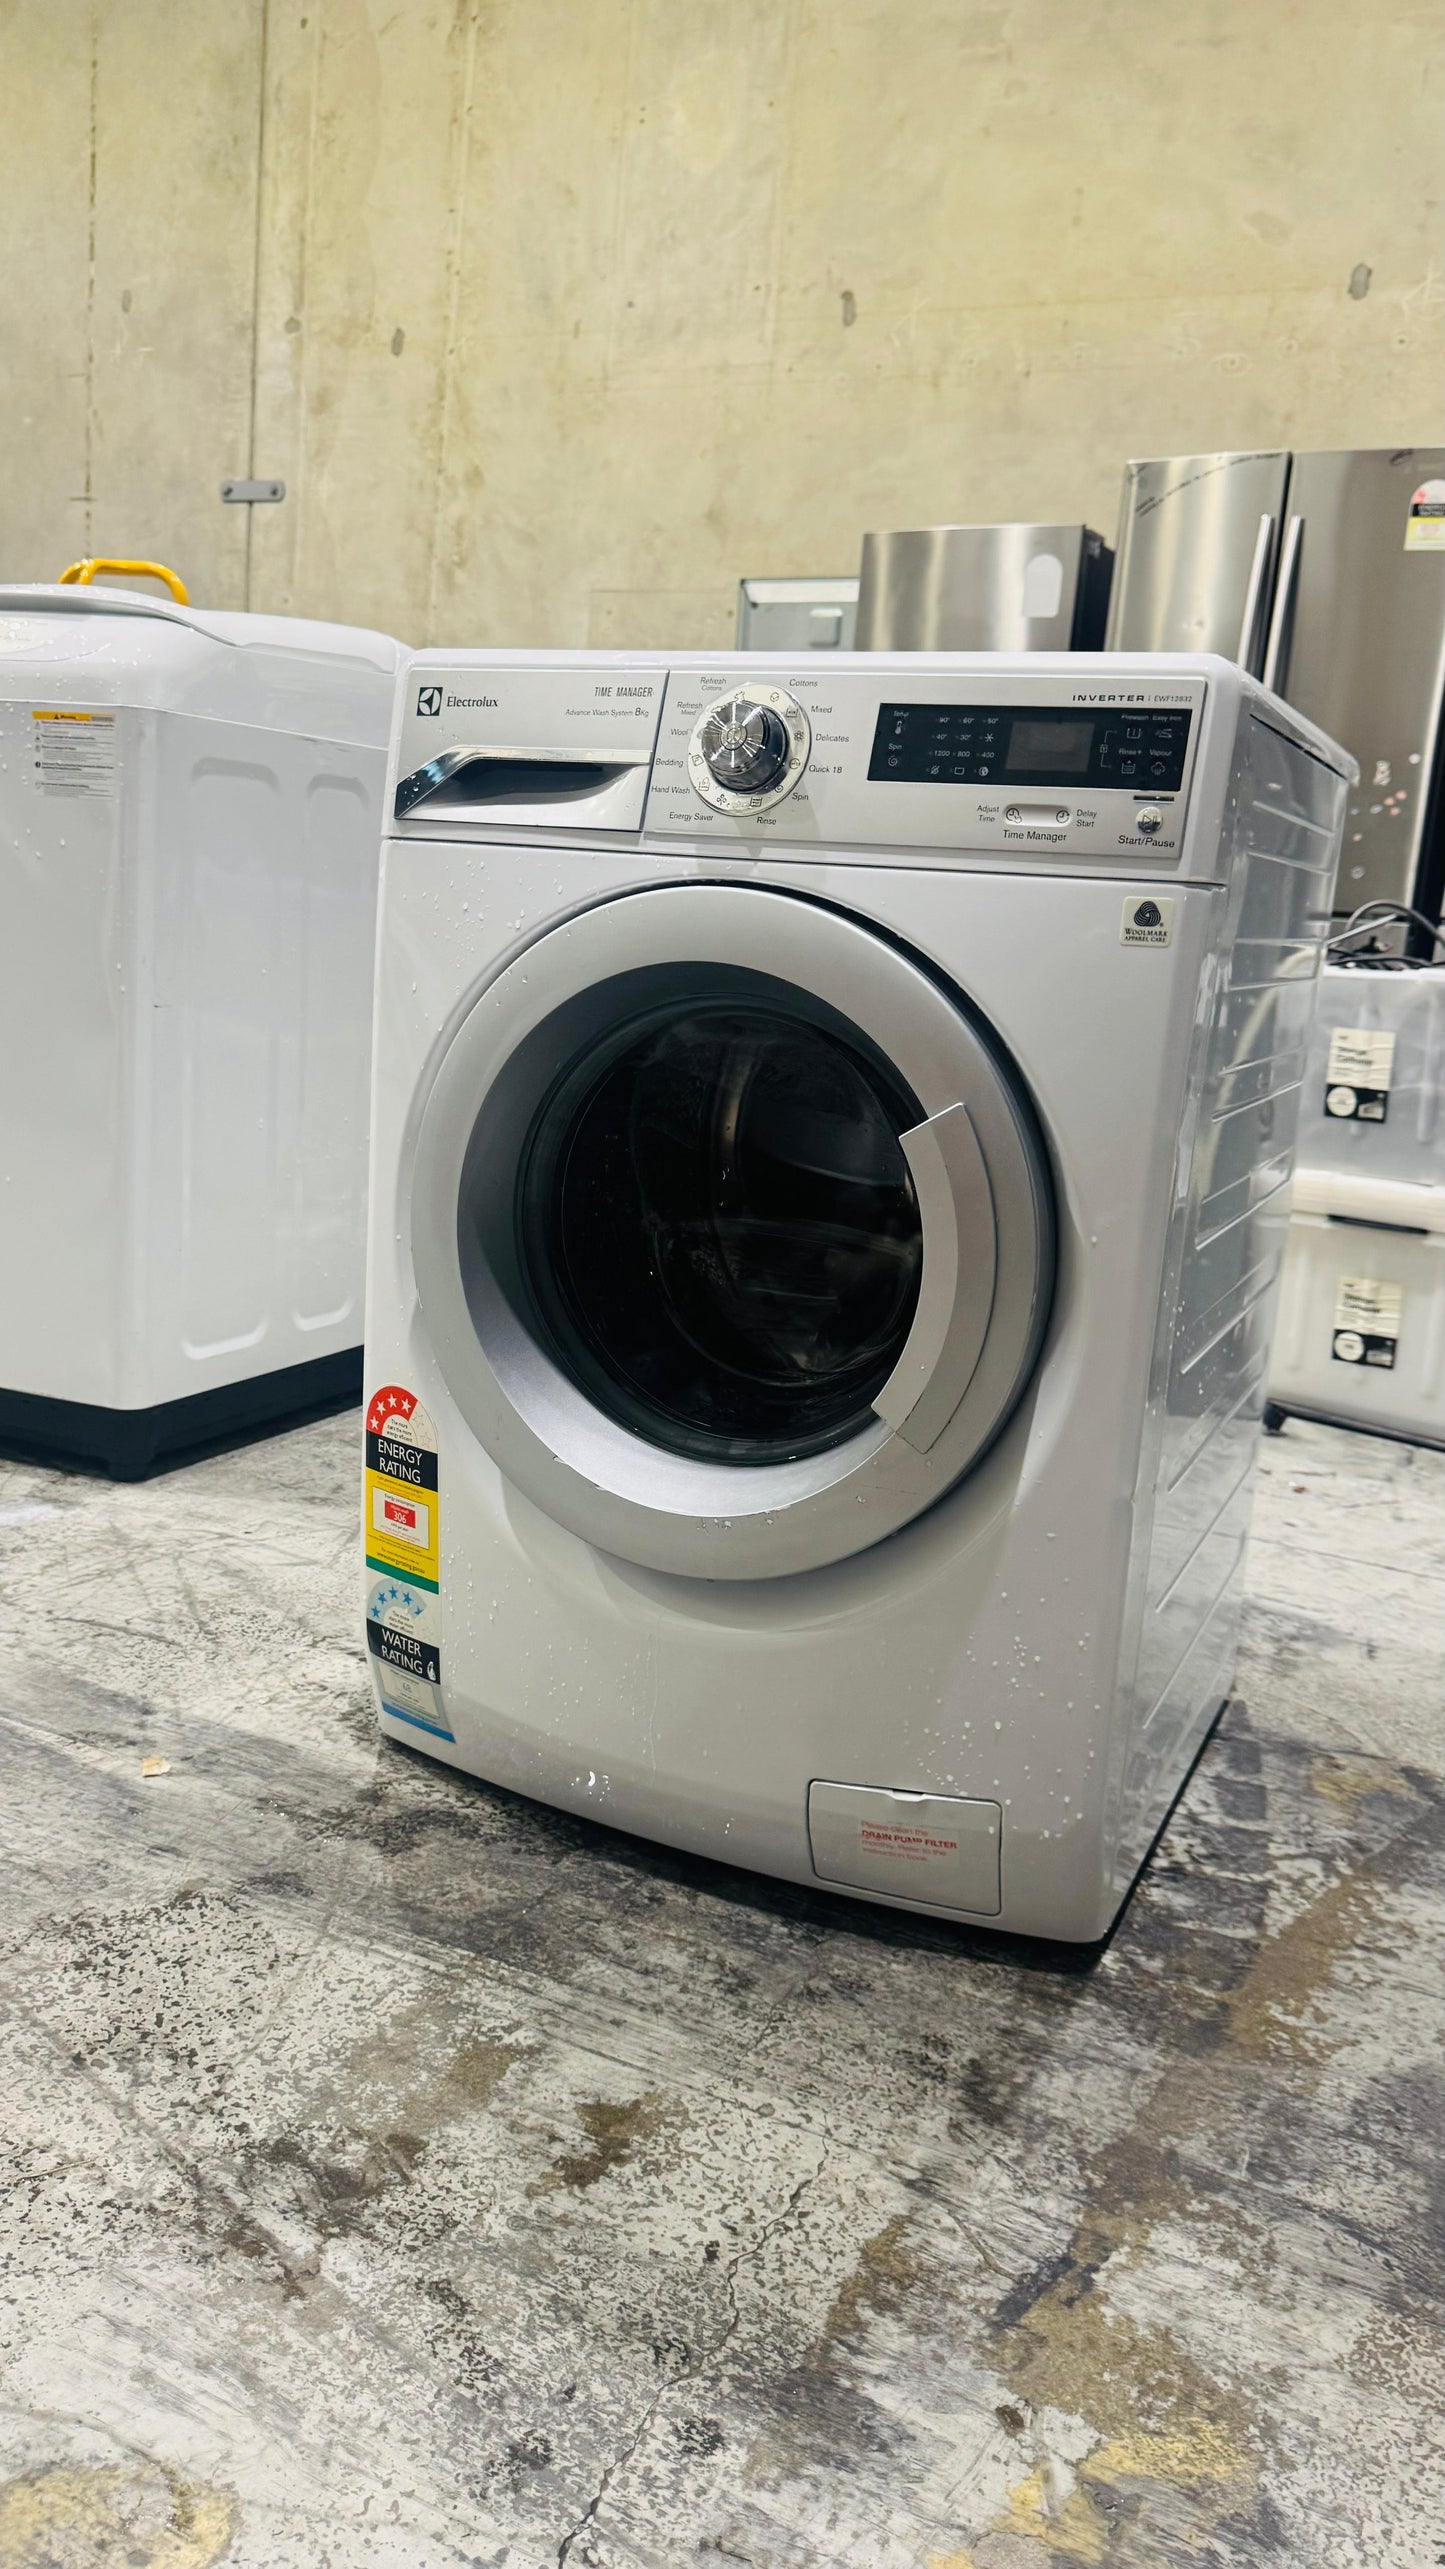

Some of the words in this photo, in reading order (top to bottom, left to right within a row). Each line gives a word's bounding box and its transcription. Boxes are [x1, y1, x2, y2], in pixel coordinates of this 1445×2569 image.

[700, 677, 726, 685] Refresh
[789, 679, 818, 687] Cottons
[594, 686, 612, 697] TIME
[616, 687, 653, 698] MANAGER
[446, 696, 499, 708] Electrolux
[1072, 694, 1145, 702] INVERTER
[677, 701, 703, 710] Refresh
[811, 706, 832, 714] Mixed
[565, 708, 591, 716] Advance
[592, 709, 610, 717] Wash
[610, 709, 634, 718] System
[670, 728, 688, 736] Wool
[816, 734, 850, 743] Delicates
[888, 743, 902, 752] Spin
[934, 750, 951, 758] 1200
[656, 758, 684, 769] Bedding
[809, 765, 832, 774] Quick
[833, 766, 842, 774] 18
[651, 785, 670, 794] Hand
[672, 786, 691, 795] Wash
[792, 792, 809, 802] Spin
[976, 804, 1000, 814] Adjust
[1076, 809, 1098, 818] Delay
[669, 812, 692, 822] Energy
[694, 813, 714, 822] Saver
[756, 816, 777, 826] Rinse
[978, 815, 996, 823] Time
[1076, 820, 1095, 828] Start
[1003, 830, 1024, 840] Time
[1026, 831, 1067, 844] Manager
[1118, 834, 1176, 849] Start/Pause
[378, 1438, 423, 1466] ENERGY
[380, 1456, 421, 1484] RATING
[394, 1510, 407, 1524] 306
[382, 1628, 422, 1657] WATER
[382, 1645, 422, 1674] RATING
[862, 1830, 892, 1842] DRAIN
[894, 1835, 922, 1844] PUMP
[924, 1838, 958, 1849] FILTER
